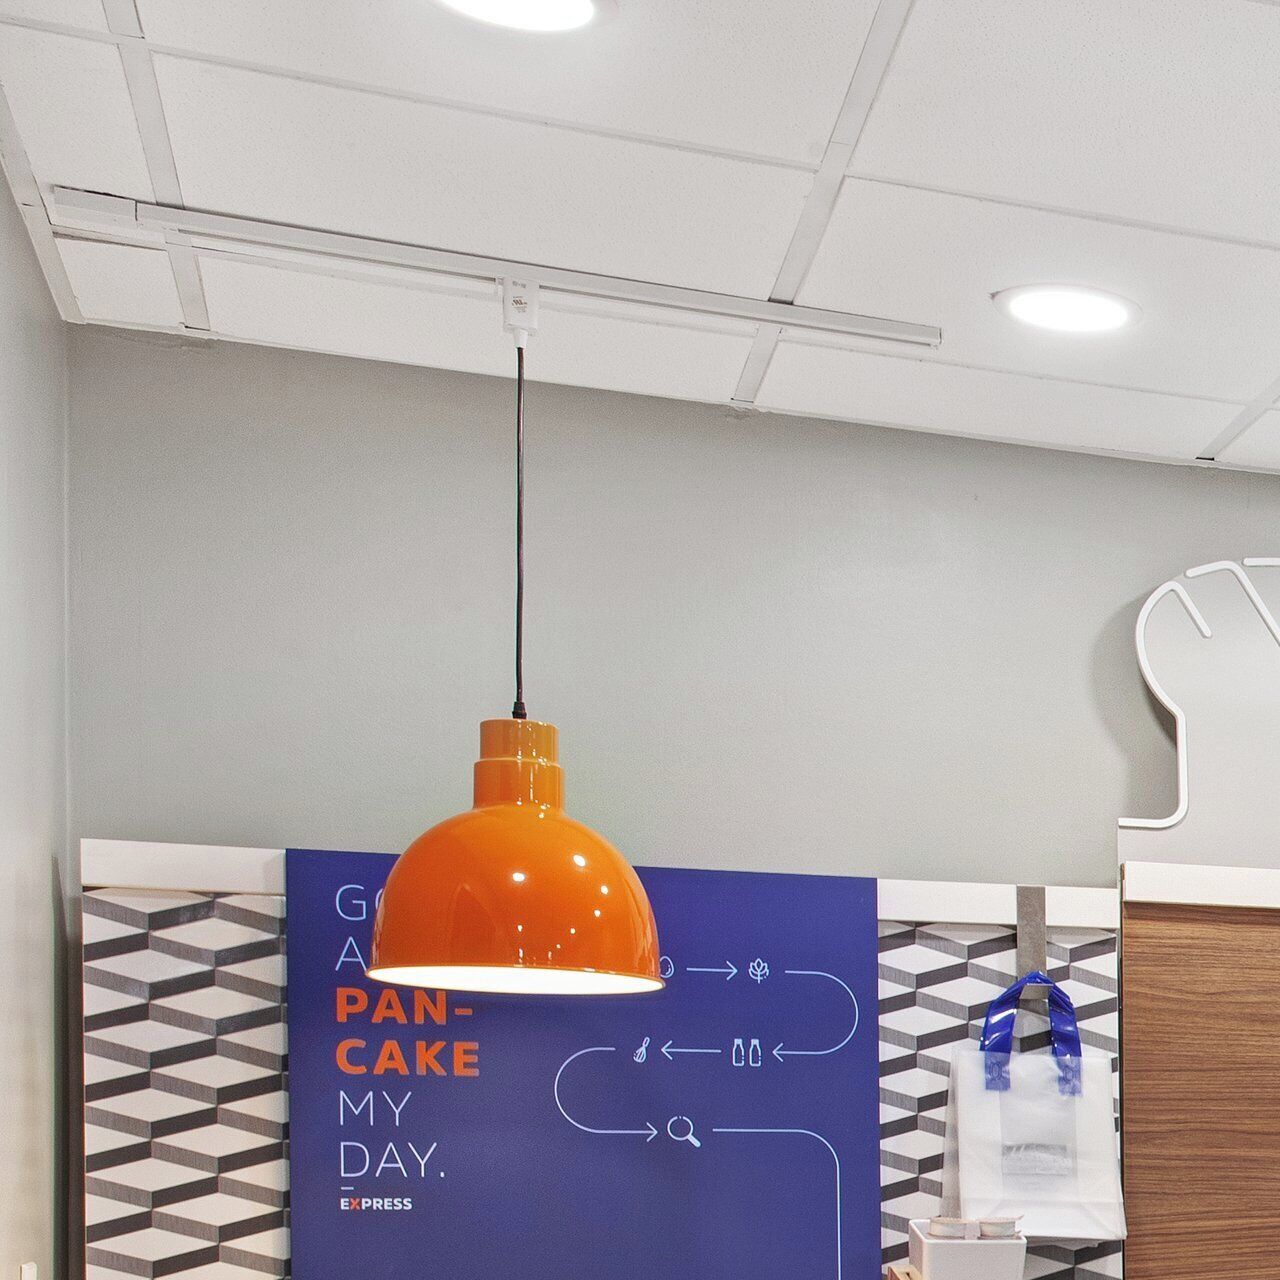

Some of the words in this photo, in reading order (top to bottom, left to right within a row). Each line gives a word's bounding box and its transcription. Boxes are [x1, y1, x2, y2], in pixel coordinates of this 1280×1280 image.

[335, 884, 384, 921] G
[335, 936, 367, 972] A
[336, 987, 473, 1026] PAN-
[336, 1038, 480, 1077] CAKE
[340, 1090, 412, 1126] MY
[341, 1141, 445, 1178] DAY.
[340, 1197, 413, 1210] EXPRESS
